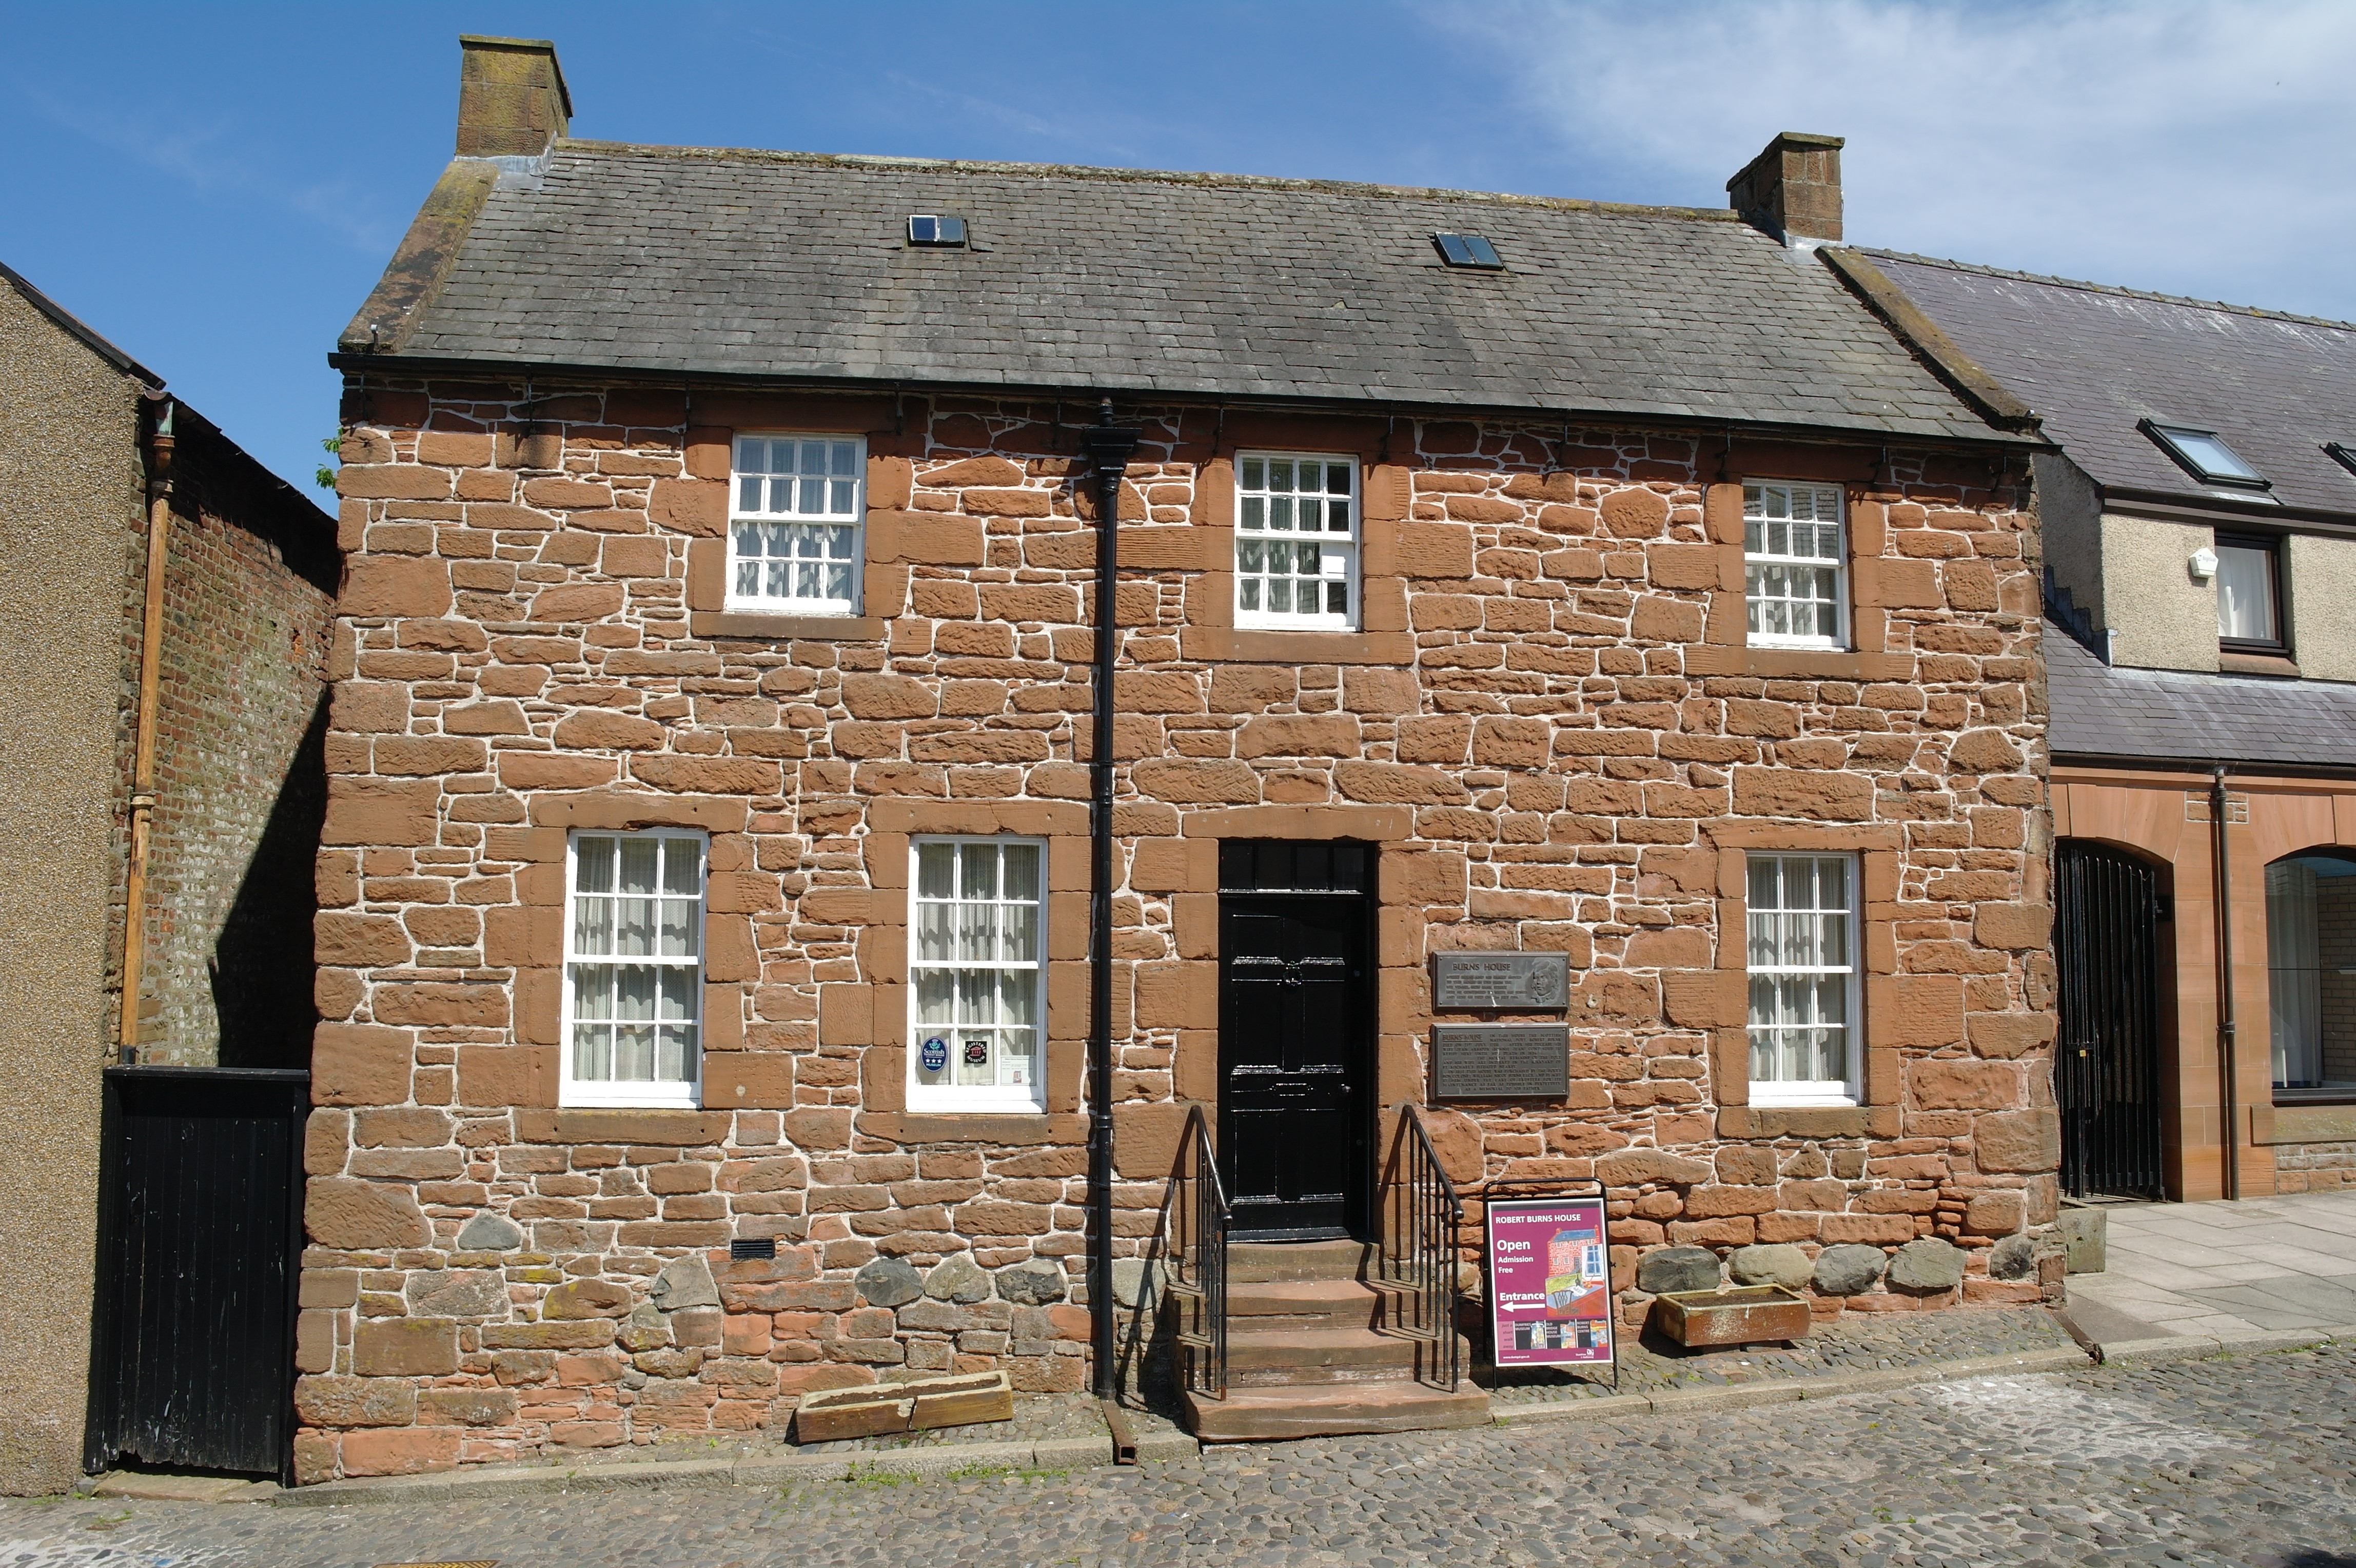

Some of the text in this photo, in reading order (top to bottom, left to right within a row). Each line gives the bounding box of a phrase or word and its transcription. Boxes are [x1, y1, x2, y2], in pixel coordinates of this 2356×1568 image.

[965, 1042, 987, 1053] REGISTERED
[1497, 1240, 1530, 1253] Open
[1499, 1292, 1545, 1301] Entrance
